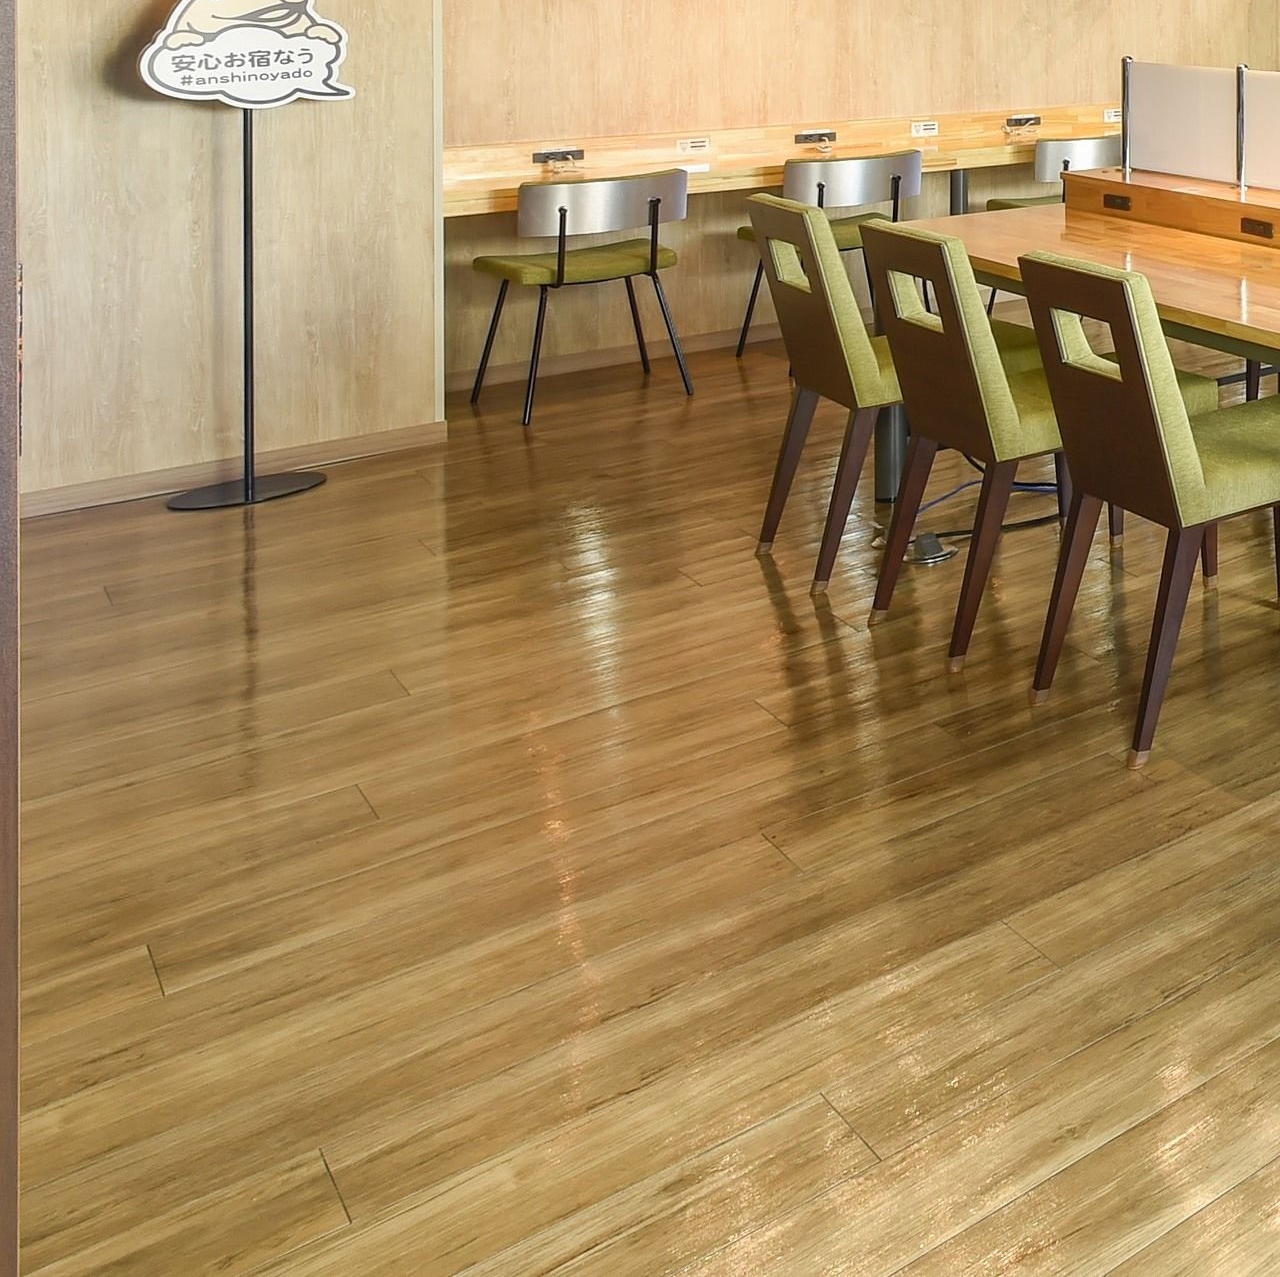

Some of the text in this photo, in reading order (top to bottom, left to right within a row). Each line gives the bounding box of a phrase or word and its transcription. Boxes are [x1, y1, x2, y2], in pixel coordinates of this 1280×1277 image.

[171, 48, 314, 74] 安心お宿なう
[180, 67, 314, 87] #anshinoyado
